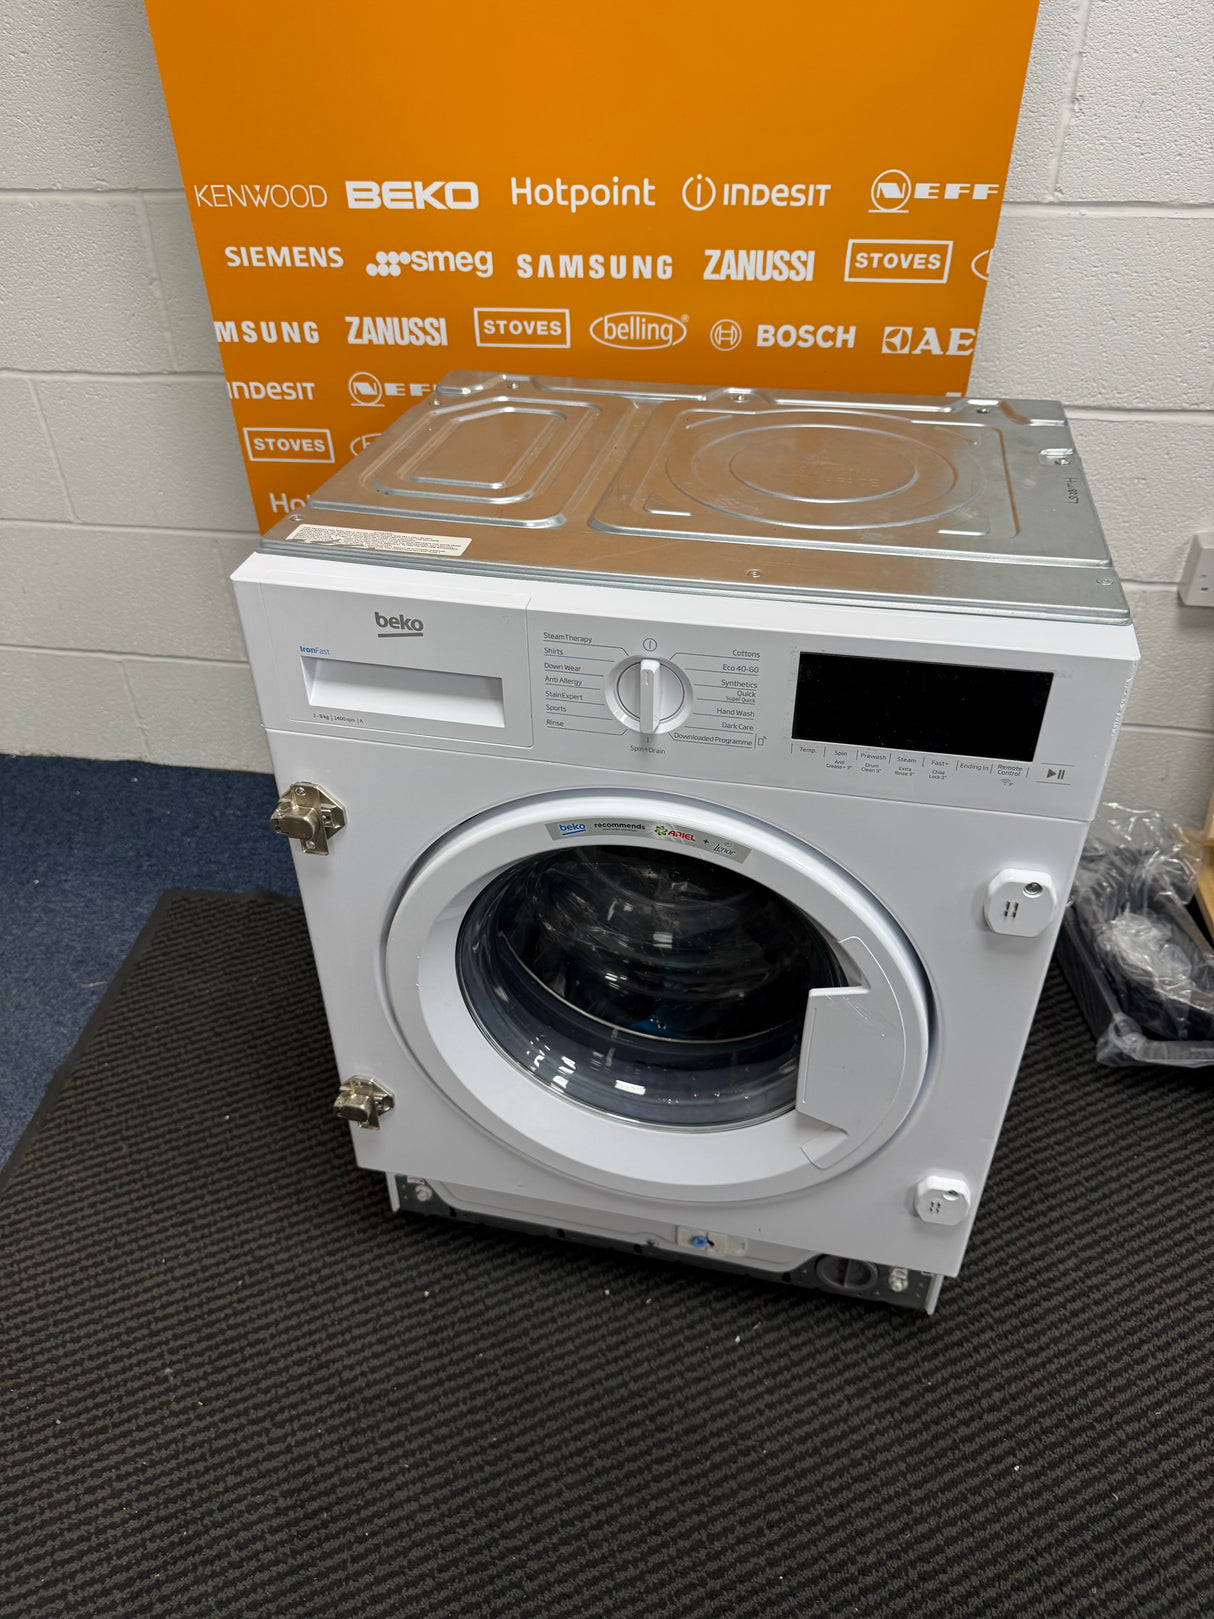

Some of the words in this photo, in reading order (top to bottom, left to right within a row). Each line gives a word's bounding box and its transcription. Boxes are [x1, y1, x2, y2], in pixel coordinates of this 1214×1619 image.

[194, 184, 328, 208] KENWOOD
[345, 180, 480, 210] BEKO
[511, 176, 656, 213] Hotpoint
[224, 246, 344, 268] SIEMENS
[855, 252, 942, 270] STOVES
[411, 250, 494, 278] smeg
[516, 254, 674, 280] SAMSUNG
[703, 249, 816, 282] ZANUSSI
[344, 316, 448, 347] ZANUSSI
[483, 319, 563, 336] STOVES
[603, 315, 674, 344] belling
[756, 324, 857, 349] BOSCH
[253, 437, 326, 453] STOVES
[374, 611, 424, 632] beko
[543, 632, 593, 644] SteamTherapy
[299, 645, 330, 656] IronFast
[544, 647, 564, 656] Shirts
[732, 649, 761, 659] Cottons
[544, 662, 565, 671] Down
[565, 664, 581, 673] Wear
[722, 664, 735, 672] Eco
[736, 665, 760, 674] 40-60
[545, 675, 558, 684] Anti
[559, 677, 583, 687] Allergy
[721, 679, 758, 690] Synthetics
[545, 690, 583, 702] StainExpert
[725, 695, 741, 703] Super
[737, 690, 757, 699] Quick
[546, 704, 567, 713] Sports
[717, 707, 734, 716] Hand
[736, 709, 755, 718] Wash
[546, 719, 564, 727] Rinse
[721, 721, 736, 730] Dark
[738, 723, 754, 731] Care
[674, 732, 713, 743] Downloaded
[714, 736, 753, 747] Programme
[860, 753, 887, 761] Prewash
[960, 763, 981, 771] Ending
[997, 769, 1021, 777] Control
[560, 823, 586, 832] beko
[594, 822, 646, 830] recommends
[668, 830, 696, 841] ARIEL
